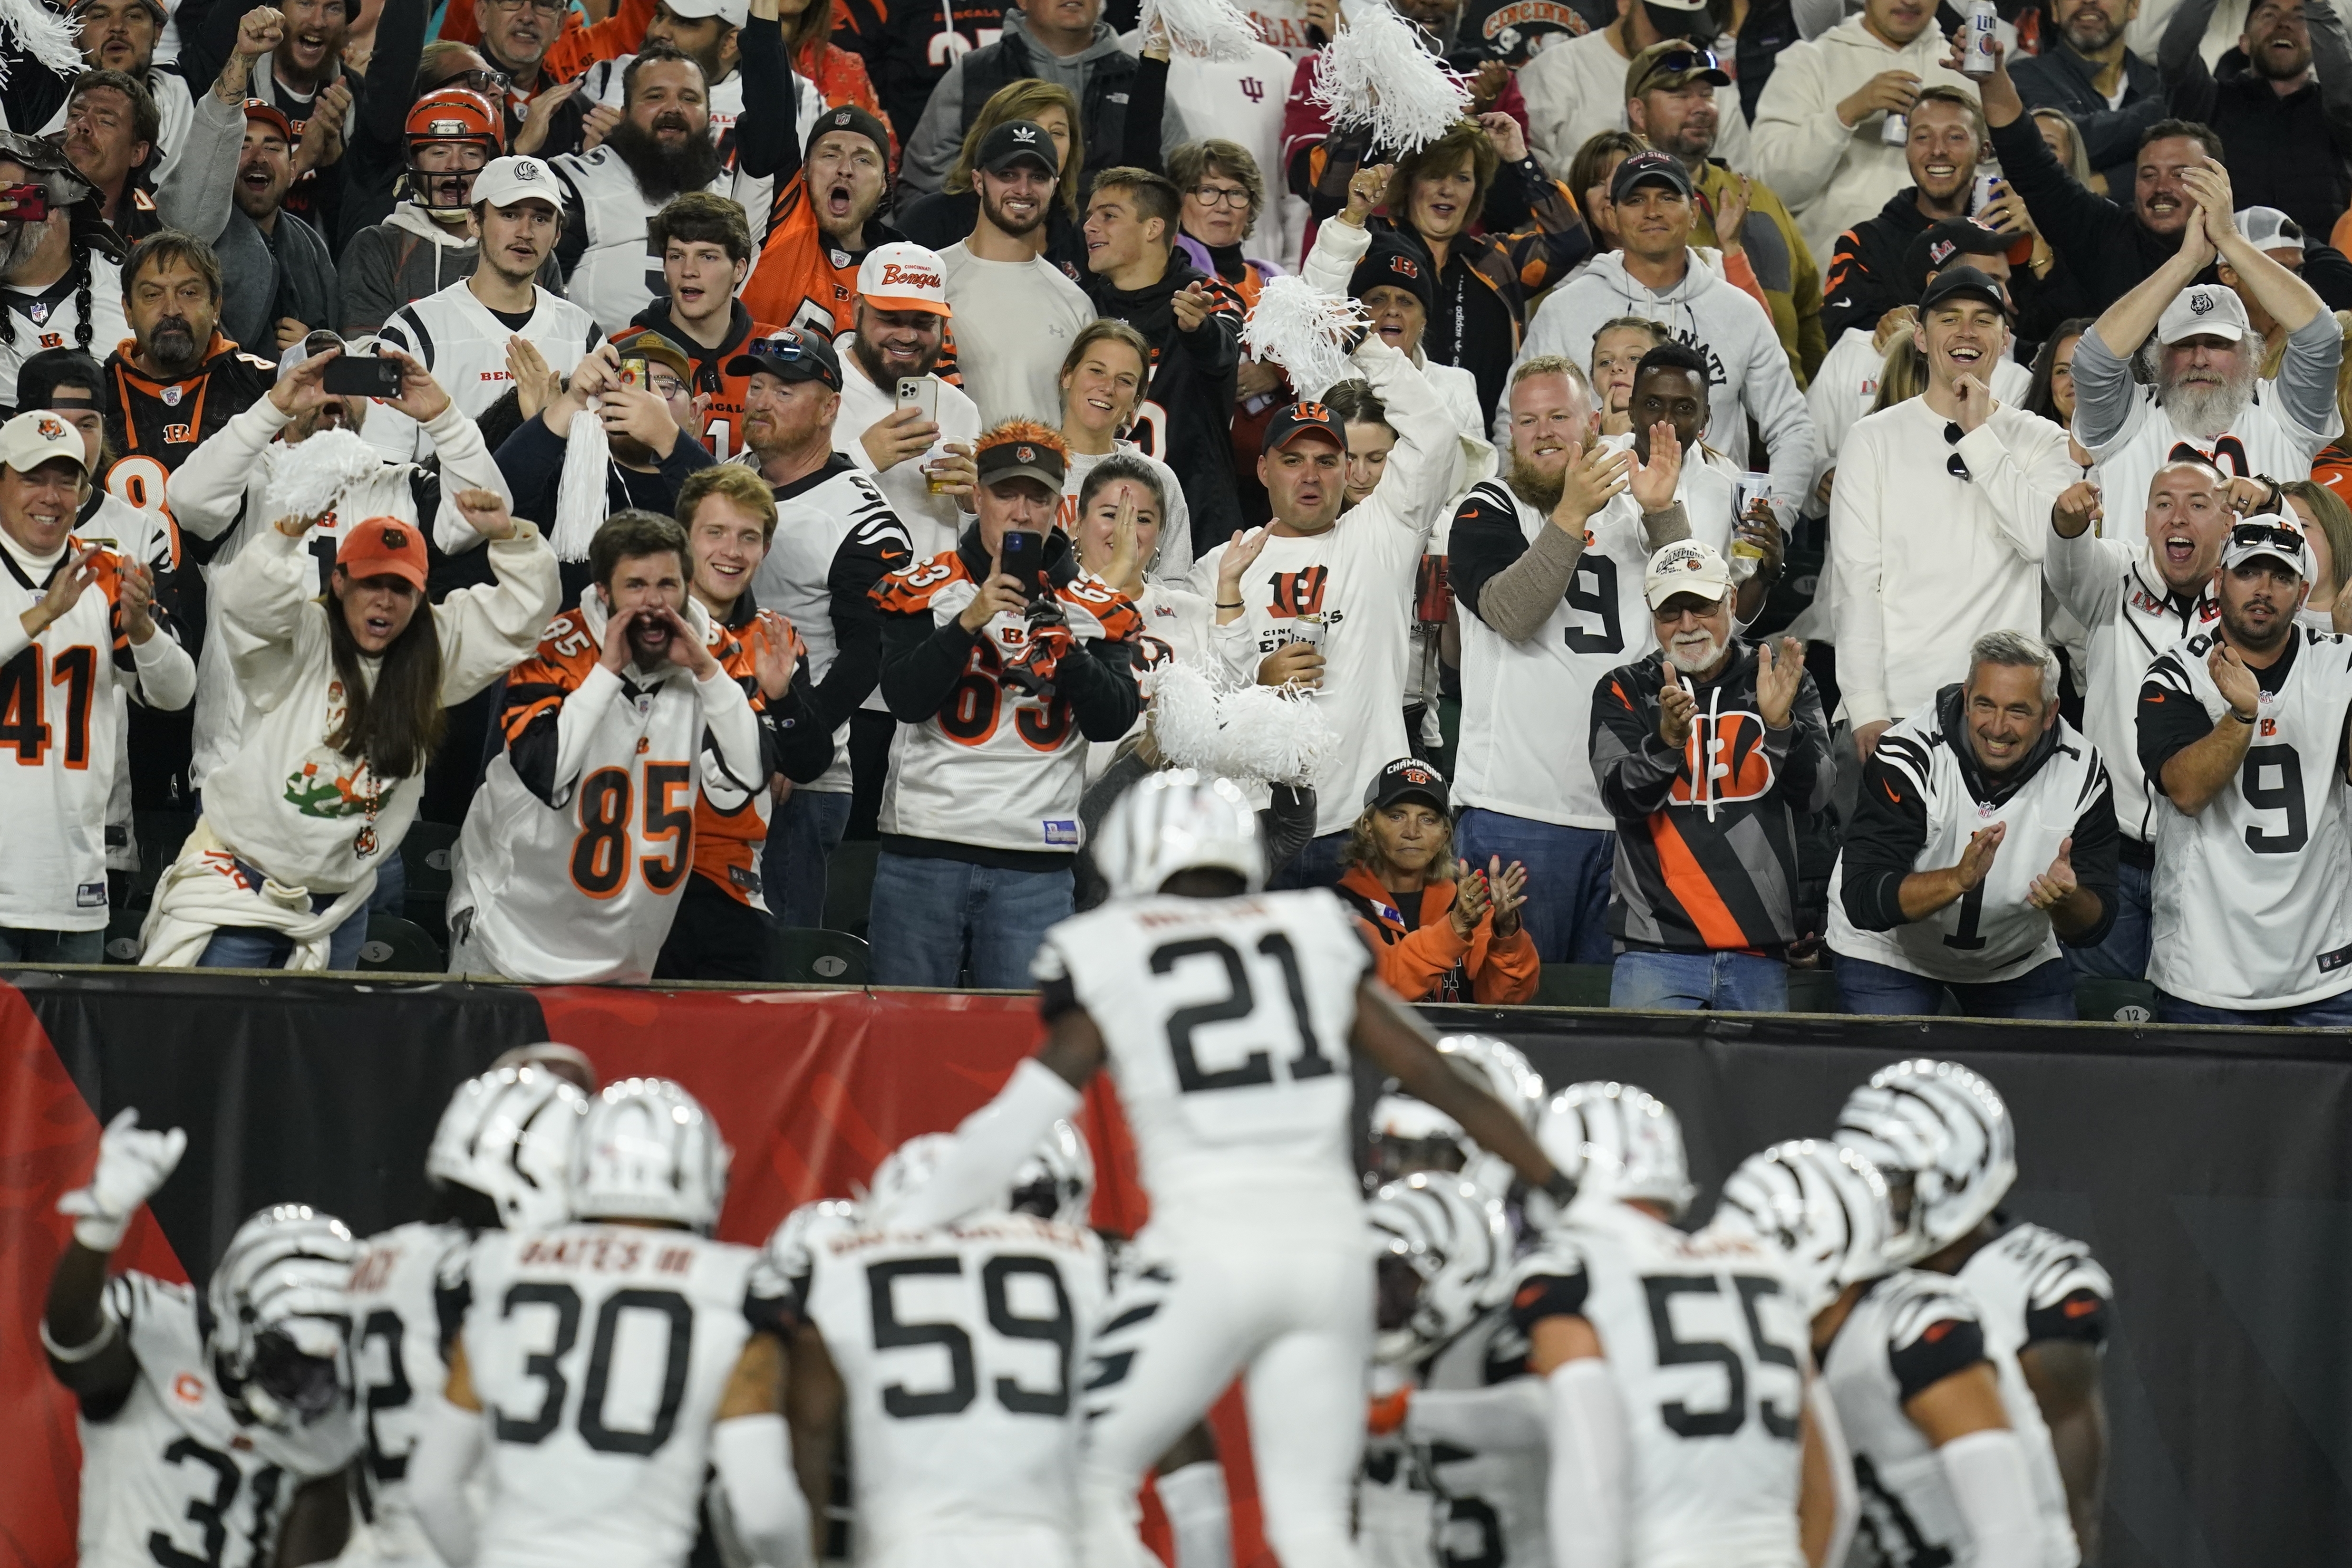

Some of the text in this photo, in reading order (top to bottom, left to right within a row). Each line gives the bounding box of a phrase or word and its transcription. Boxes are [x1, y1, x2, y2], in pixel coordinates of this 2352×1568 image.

[1627, 151, 1671, 164] OHIO STATE
[881, 264, 940, 289] Bengals
[480, 372, 511, 381] BEN
[1656, 550, 1705, 573] CHAMPIONS
[0, 642, 98, 770] 41
[1387, 758, 1443, 783] CHAMPIONS
[2241, 742, 2309, 854] 9
[571, 761, 696, 900] 85
[1150, 933, 1335, 1094] 21
[2125, 1009, 2140, 1021] 12
[496, 1282, 696, 1458] 30
[865, 1256, 1076, 1419] 59
[1641, 1274, 1803, 1443] 55
